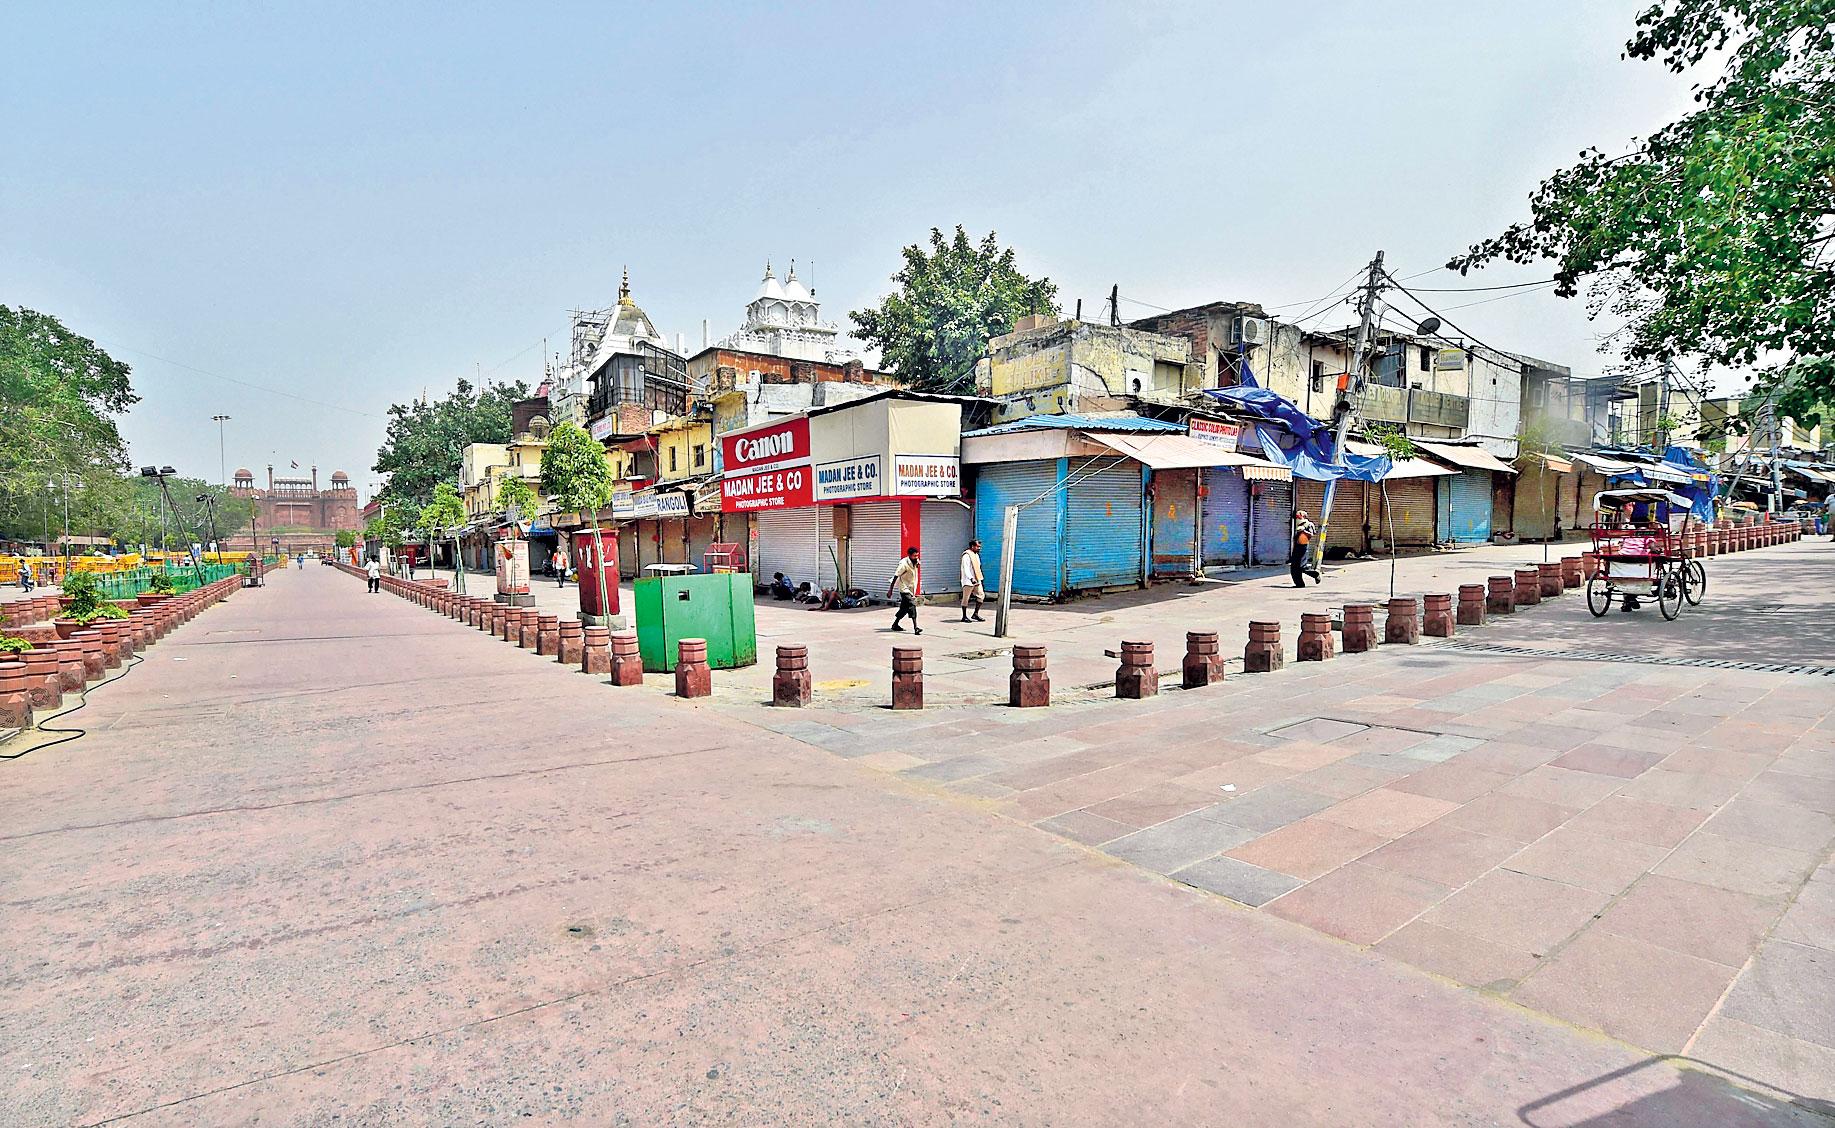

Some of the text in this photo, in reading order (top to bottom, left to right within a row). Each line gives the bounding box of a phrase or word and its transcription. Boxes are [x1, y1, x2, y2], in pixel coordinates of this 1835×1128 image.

[735, 430, 794, 463] Canon
[818, 463, 878, 484] MADAN JEE & CO.
[898, 464, 958, 478] MADAN JEE & CO.
[724, 470, 802, 497] MADAN JEE & CO
[823, 481, 873, 494] PHOTOGRAPHIC STORE
[900, 480, 956, 488] PHOTOGRAPHIC STORE
[657, 495, 687, 511] RANGOLI
[735, 496, 785, 509] PHOTOGRAPHIC STORE
